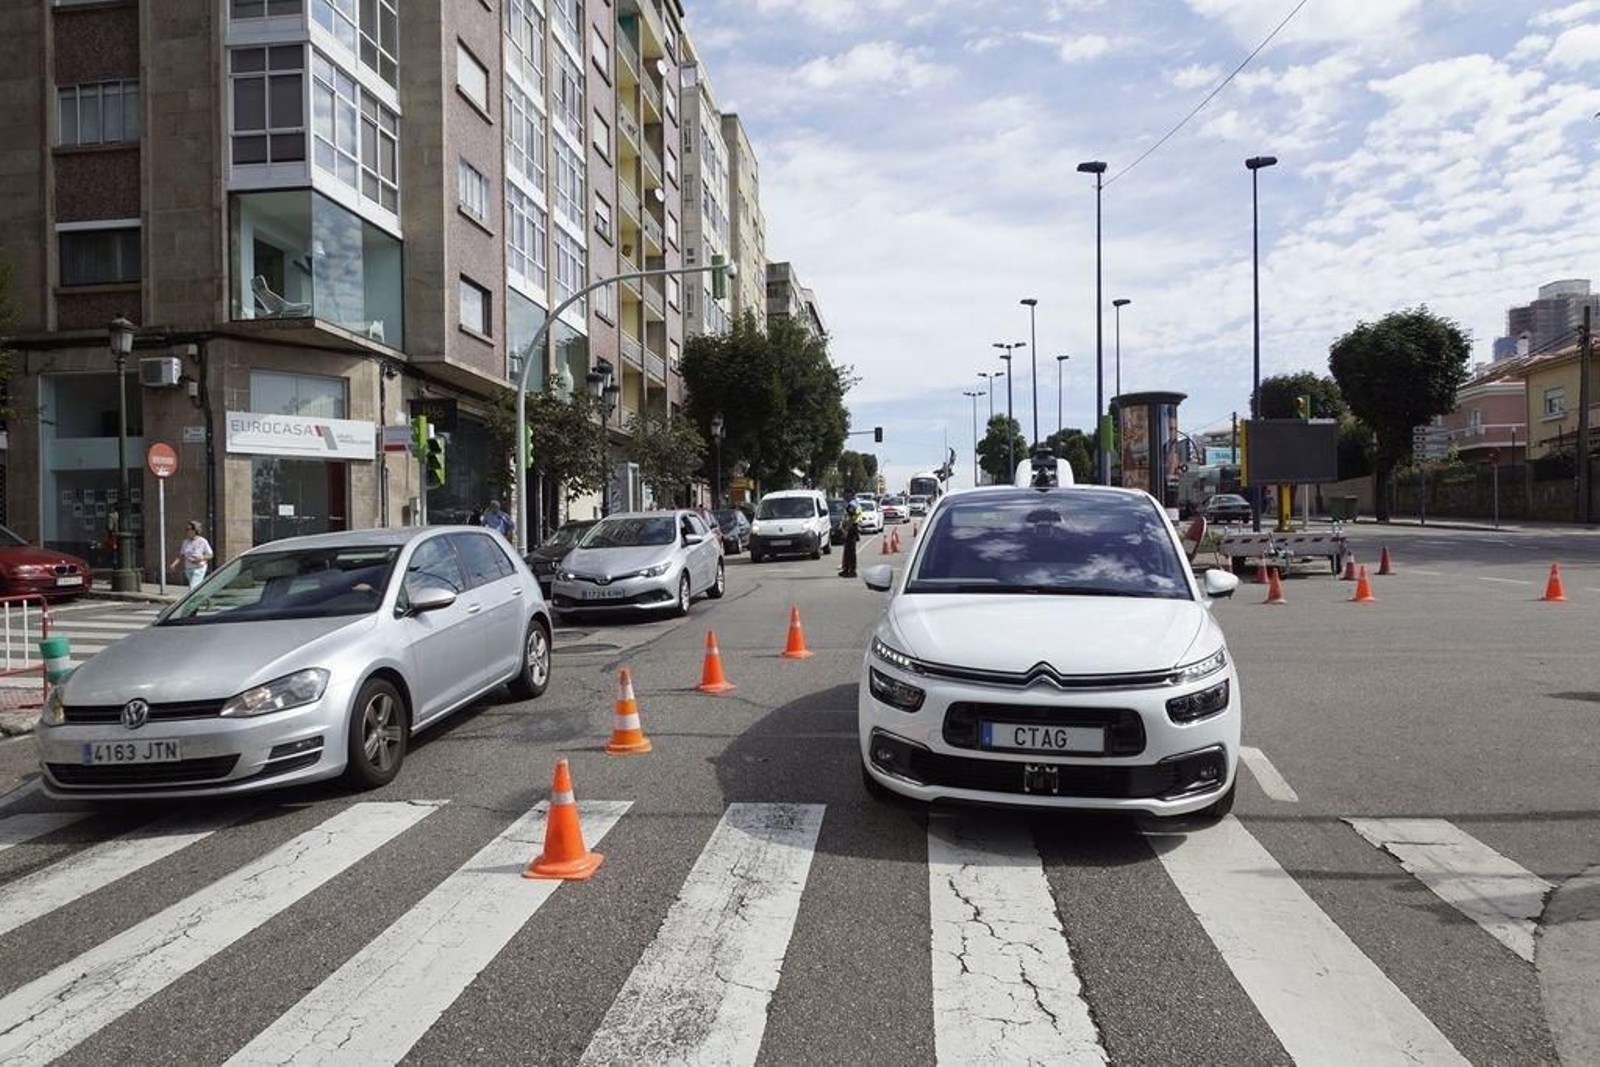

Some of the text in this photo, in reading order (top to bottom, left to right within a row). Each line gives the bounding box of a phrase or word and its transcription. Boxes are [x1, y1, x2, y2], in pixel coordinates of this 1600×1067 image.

[230, 419, 313, 436] EUROCASA
[1014, 727, 1068, 749] CTAG
[94, 742, 178, 761] 4163 JTN
